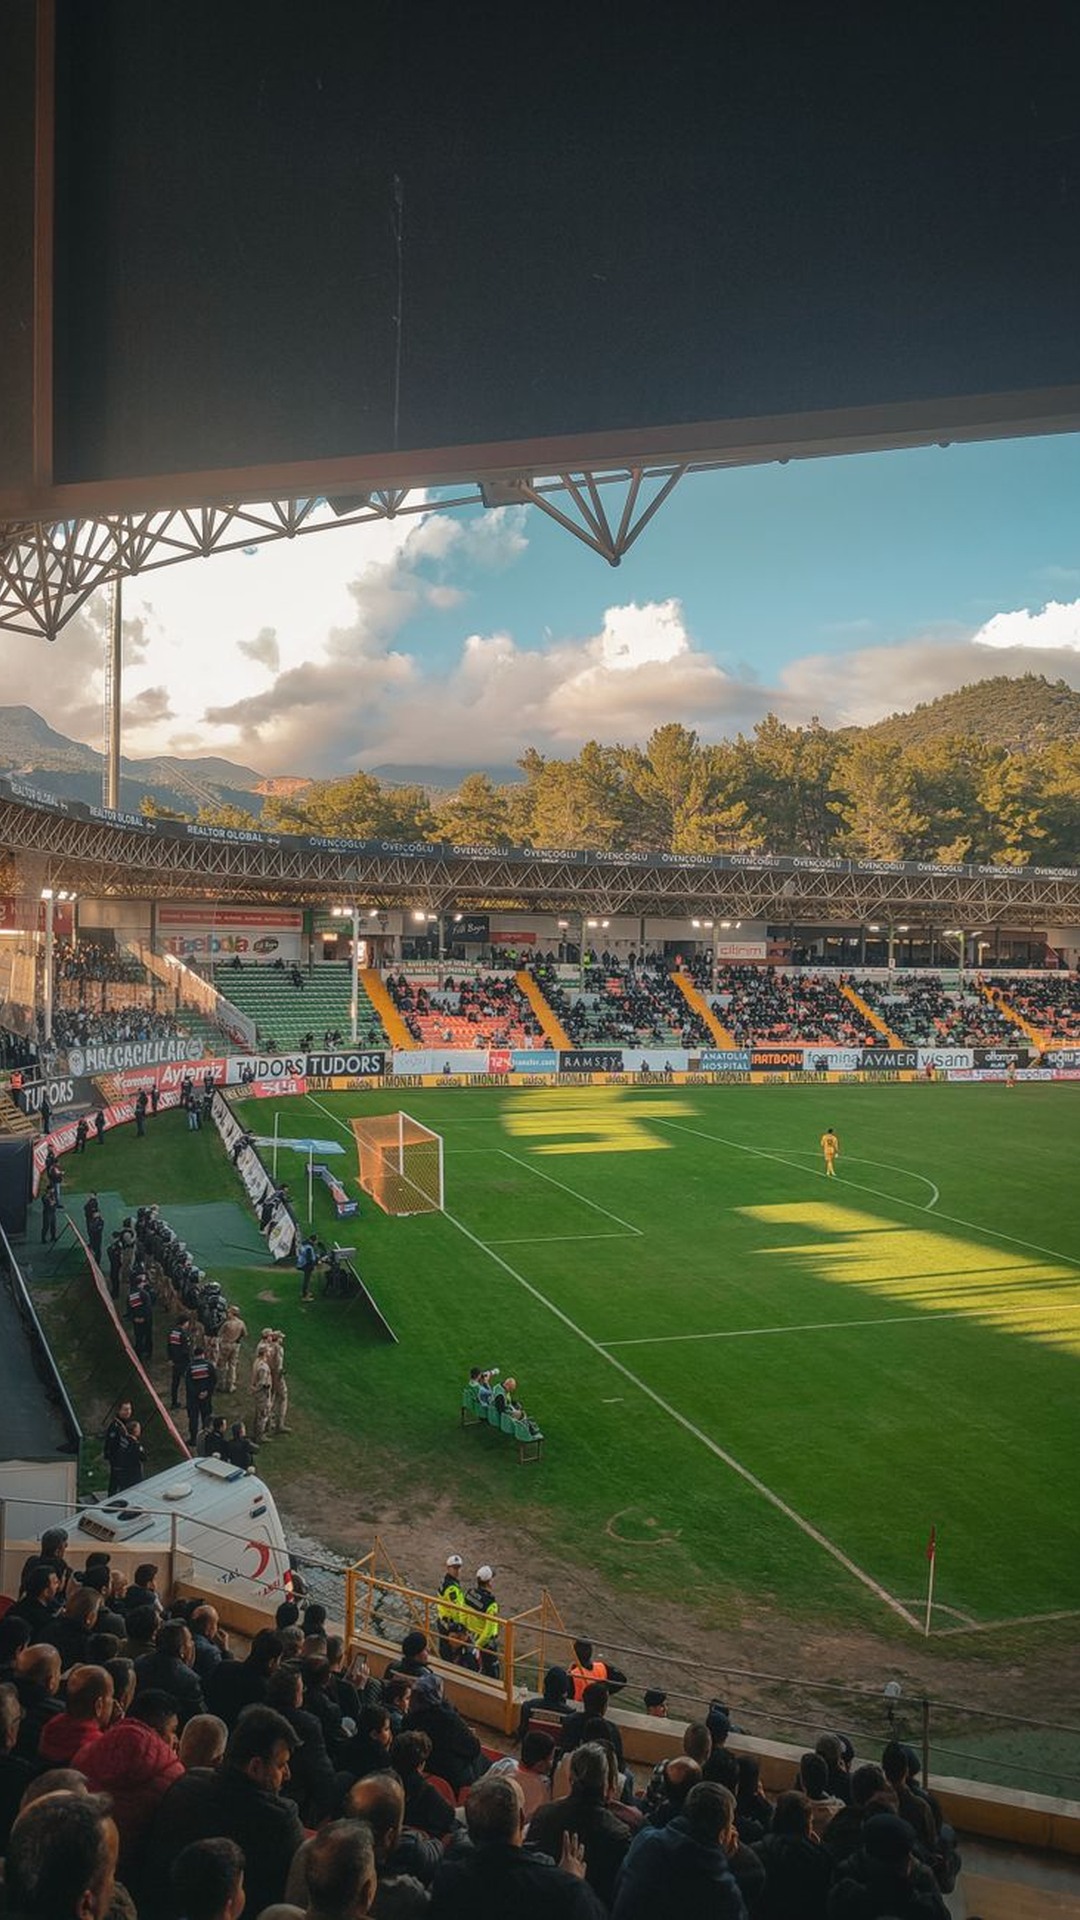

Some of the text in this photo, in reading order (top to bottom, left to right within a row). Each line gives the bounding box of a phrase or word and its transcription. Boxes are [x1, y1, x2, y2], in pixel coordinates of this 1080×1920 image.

[90, 806, 117, 821] REALTOR
[118, 812, 144, 827] GLOBAL
[187, 825, 225, 838] REALTOR
[226, 829, 263, 842] GLOBAL
[310, 1055, 381, 1075] TUDORS
[702, 1052, 749, 1061] ANATOLIA
[702, 1062, 749, 1071] HOSPITAL
[161, 1061, 224, 1085] Aytemiz
[236, 1058, 304, 1078] TUDORS
